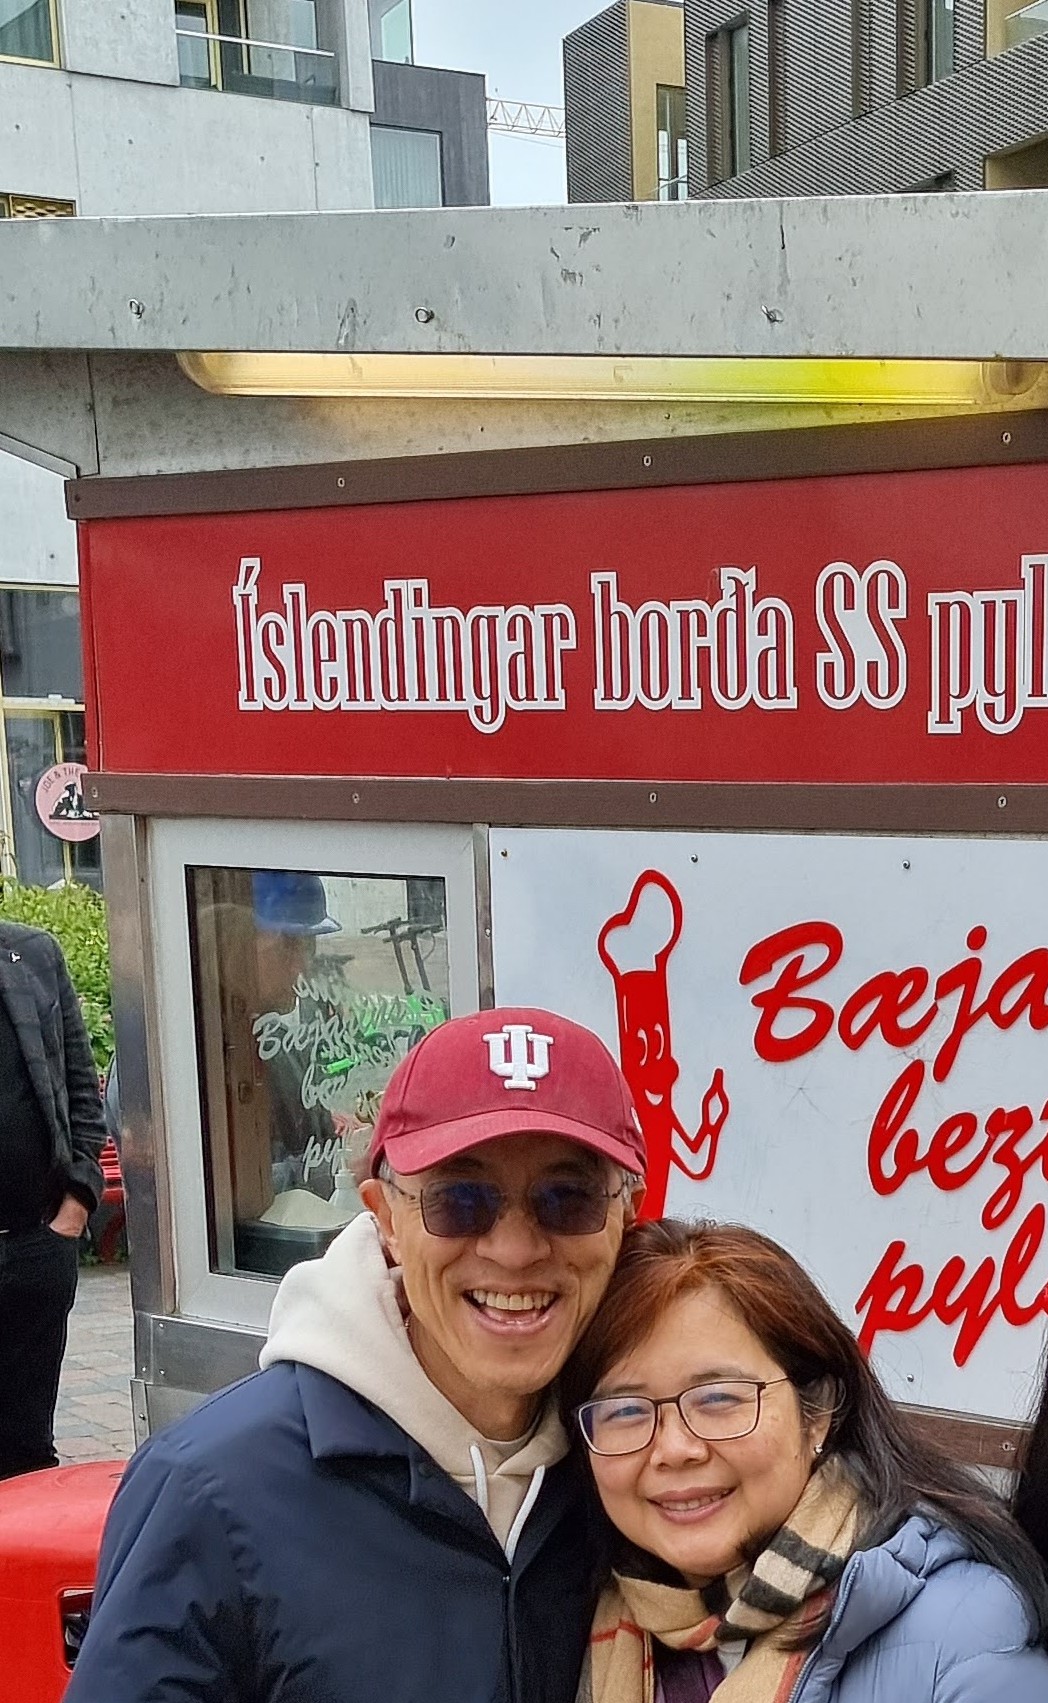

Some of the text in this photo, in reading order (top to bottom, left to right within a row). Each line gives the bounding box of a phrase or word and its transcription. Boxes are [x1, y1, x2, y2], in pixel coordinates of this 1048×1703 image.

[234, 557, 577, 734] Íslendingar
[590, 566, 798, 710] borða
[815, 559, 908, 711] SS
